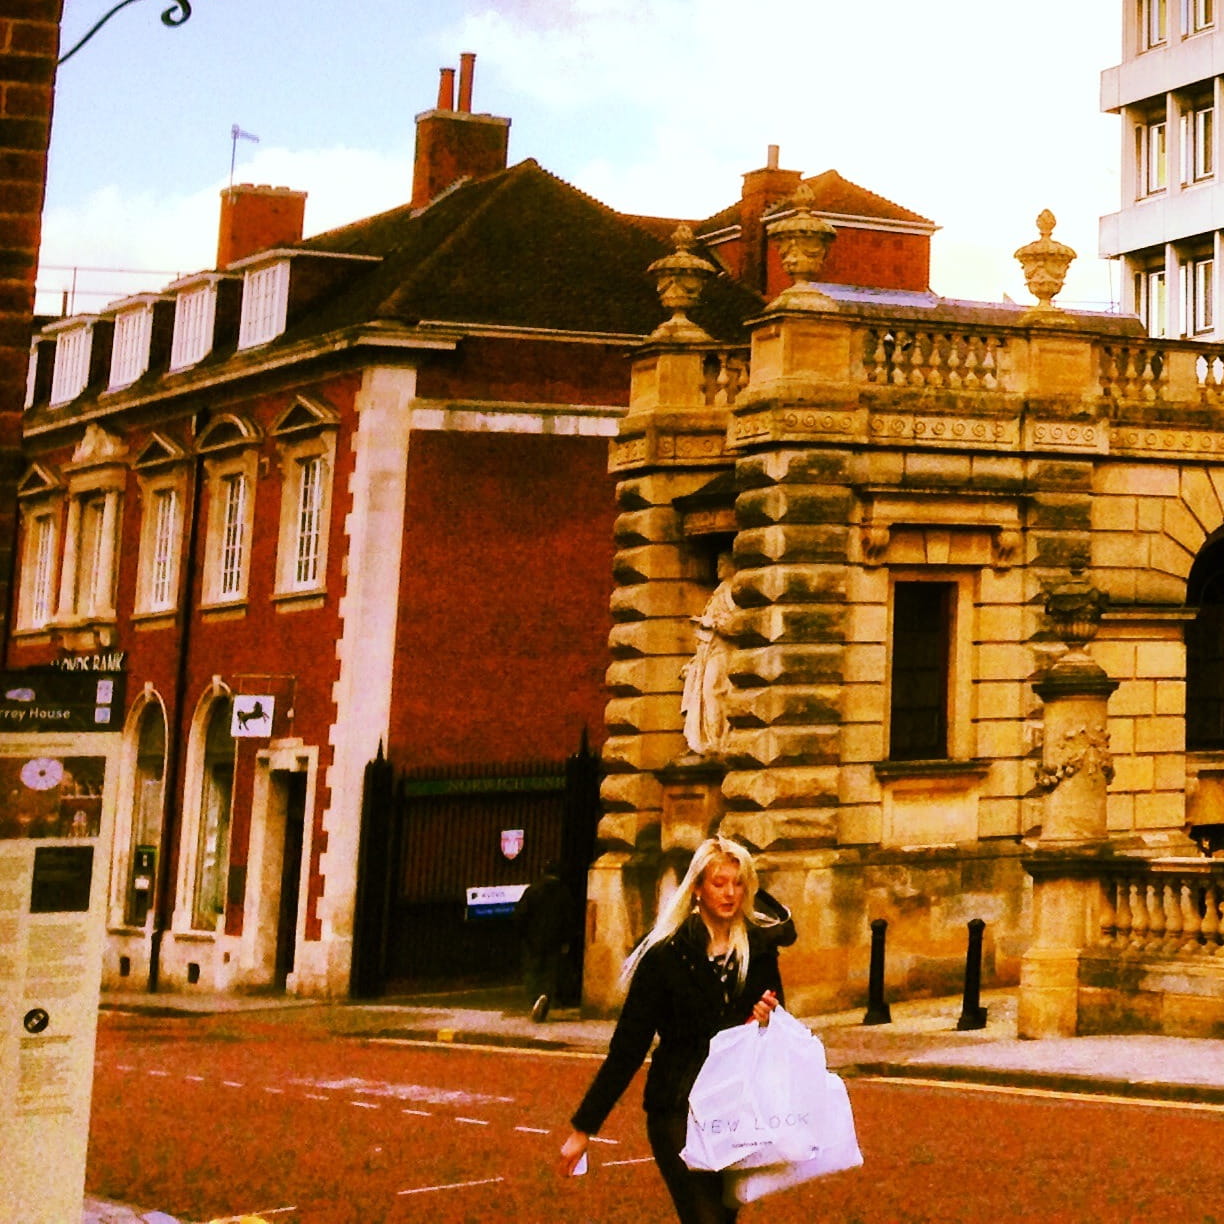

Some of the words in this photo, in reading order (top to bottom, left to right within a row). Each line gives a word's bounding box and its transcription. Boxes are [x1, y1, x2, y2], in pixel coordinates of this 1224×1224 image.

[0, 708, 26, 721] rey
[29, 707, 71, 719] House
[754, 1113, 809, 1131] LOOK
